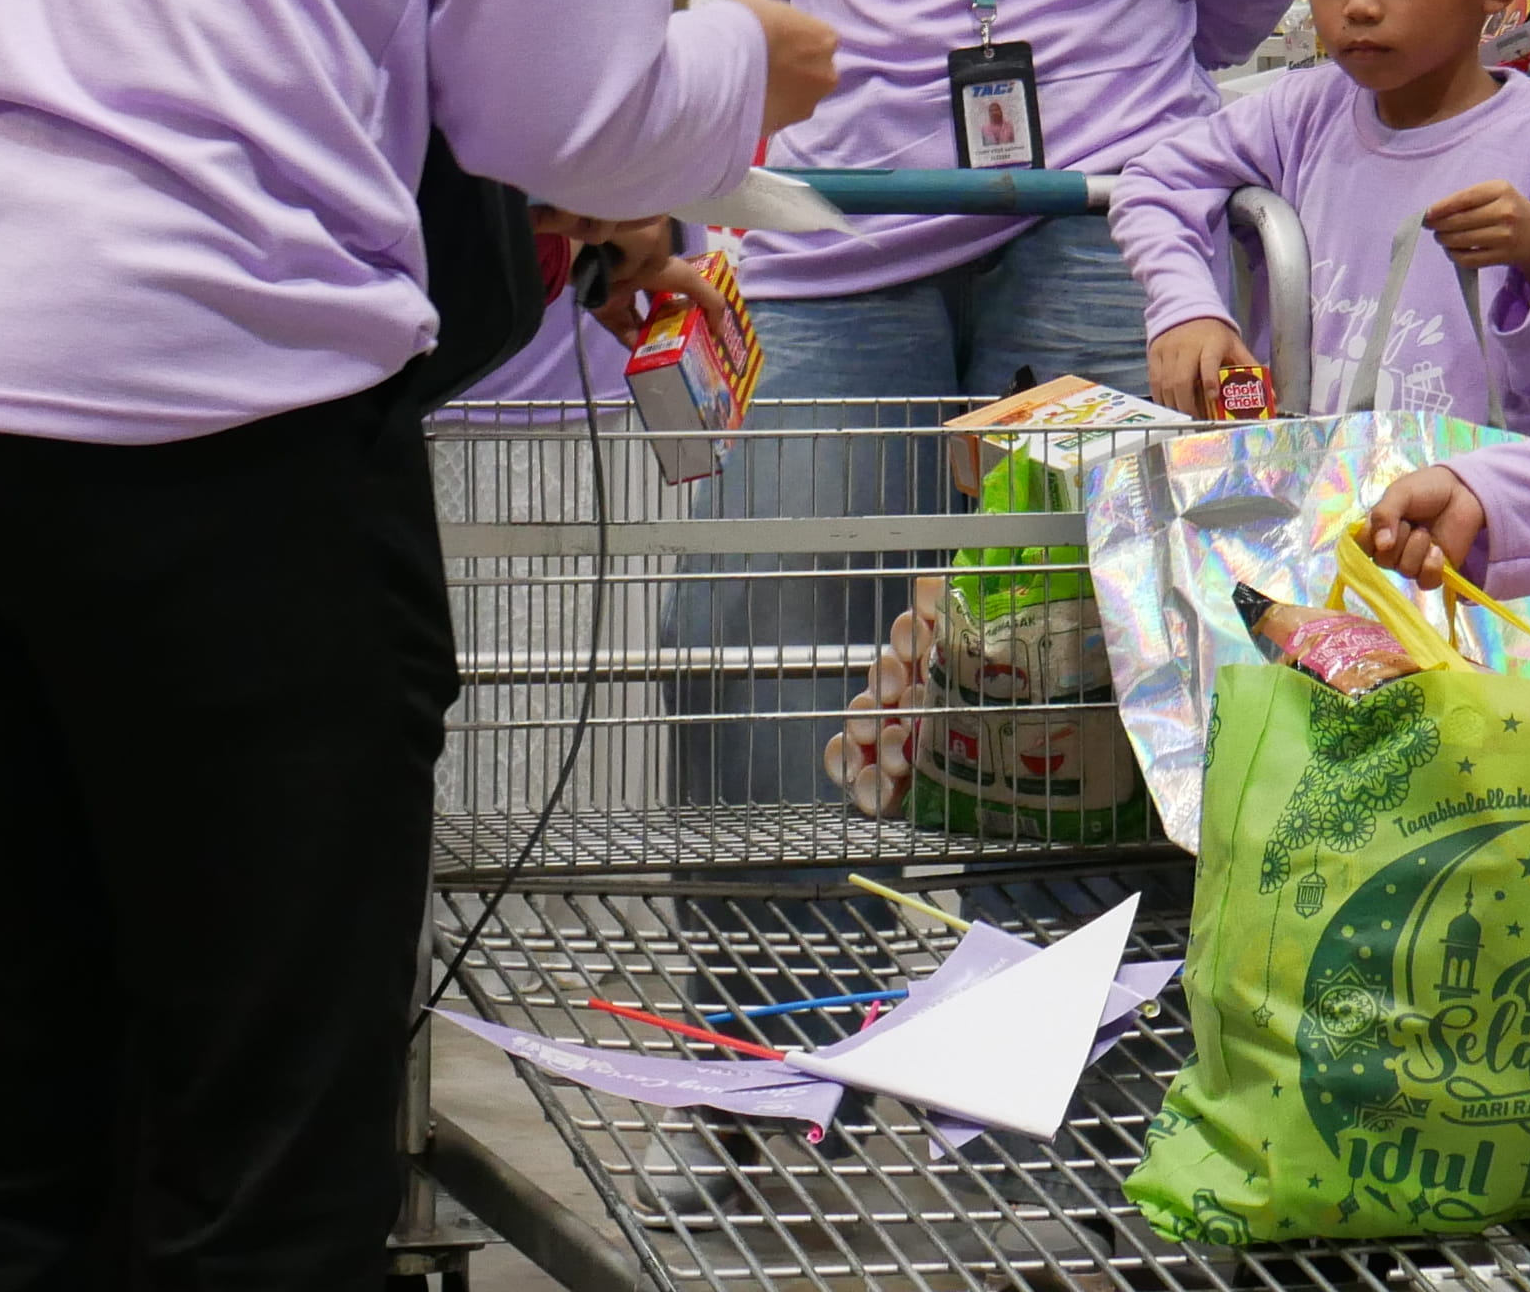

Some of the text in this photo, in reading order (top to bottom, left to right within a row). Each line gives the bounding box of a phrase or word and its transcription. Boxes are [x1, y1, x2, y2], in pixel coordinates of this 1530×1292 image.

[1223, 380, 1264, 398] choki
[1224, 395, 1266, 411] choki
[1461, 1100, 1509, 1120] HARI
